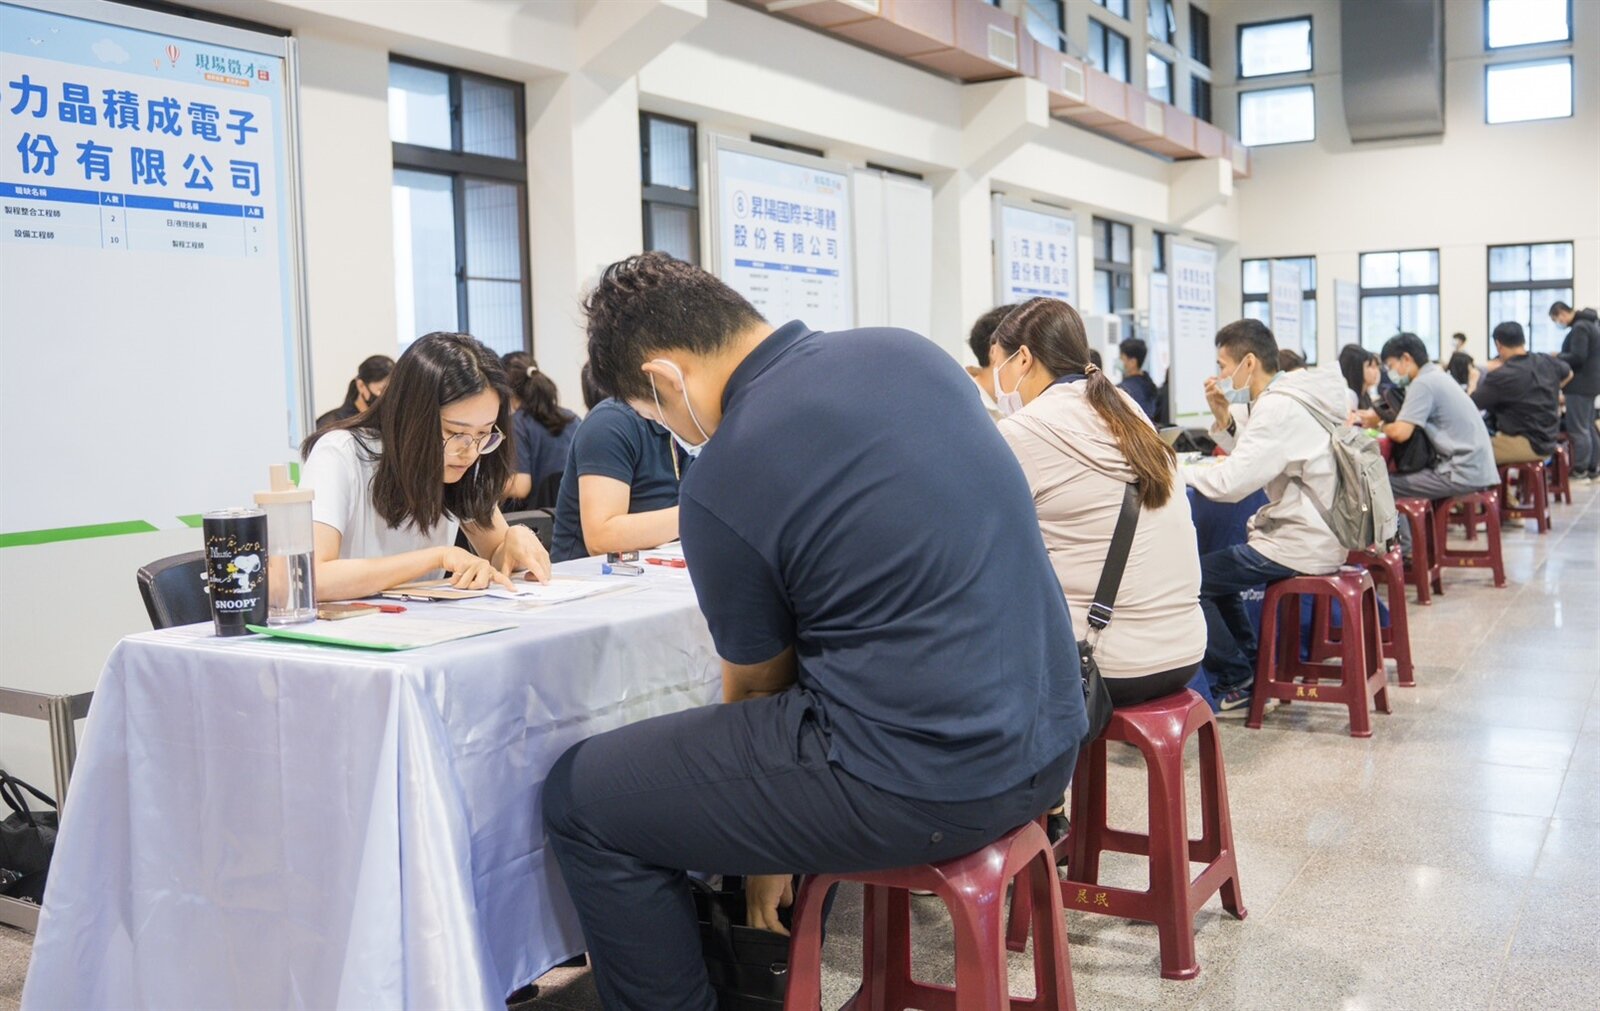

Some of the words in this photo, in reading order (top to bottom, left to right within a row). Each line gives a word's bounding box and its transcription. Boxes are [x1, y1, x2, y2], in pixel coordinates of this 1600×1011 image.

[9, 74, 258, 145] 力晶積成電子
[17, 132, 260, 196] 份有限公司
[4, 206, 61, 217] 製程整合工程師
[14, 229, 55, 239] 設備工程師
[734, 224, 837, 259] 股份有限公司
[215, 598, 257, 609] SNOOPY
